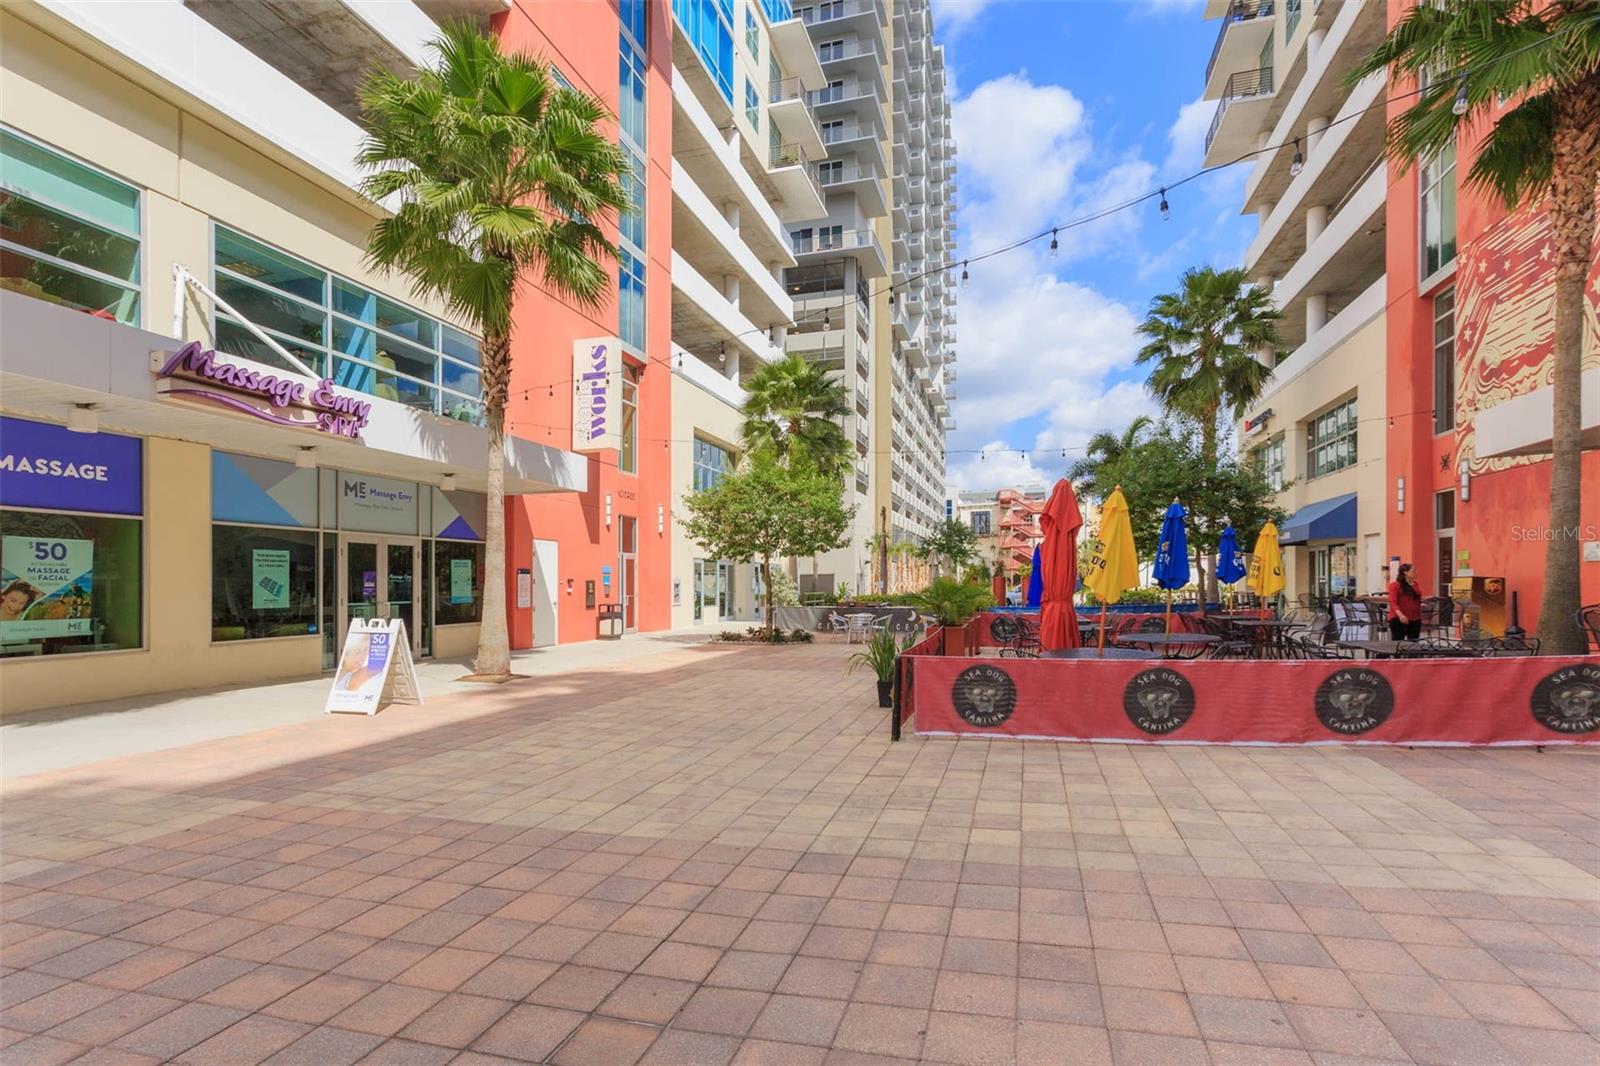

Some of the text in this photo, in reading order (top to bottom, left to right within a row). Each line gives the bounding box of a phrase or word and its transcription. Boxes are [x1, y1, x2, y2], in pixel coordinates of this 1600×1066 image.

[156, 341, 372, 428] Massage Envy
[582, 344, 607, 440] works
[316, 413, 361, 438] SPA
[0, 455, 108, 481] MASSAGE
[344, 480, 366, 499] ME
[369, 488, 413, 503] Massage Envy
[28, 541, 67, 561] $50
[38, 574, 69, 582] FACIAL
[964, 669, 1005, 682] SEA DOG
[1137, 672, 1182, 686] SEA DOG
[1330, 673, 1380, 686] SEA DOG
[1551, 670, 1576, 684] SEA
[965, 710, 1004, 724] CANTINA
[1138, 717, 1180, 731] CANTINA
[1328, 717, 1377, 731] CANTINA
